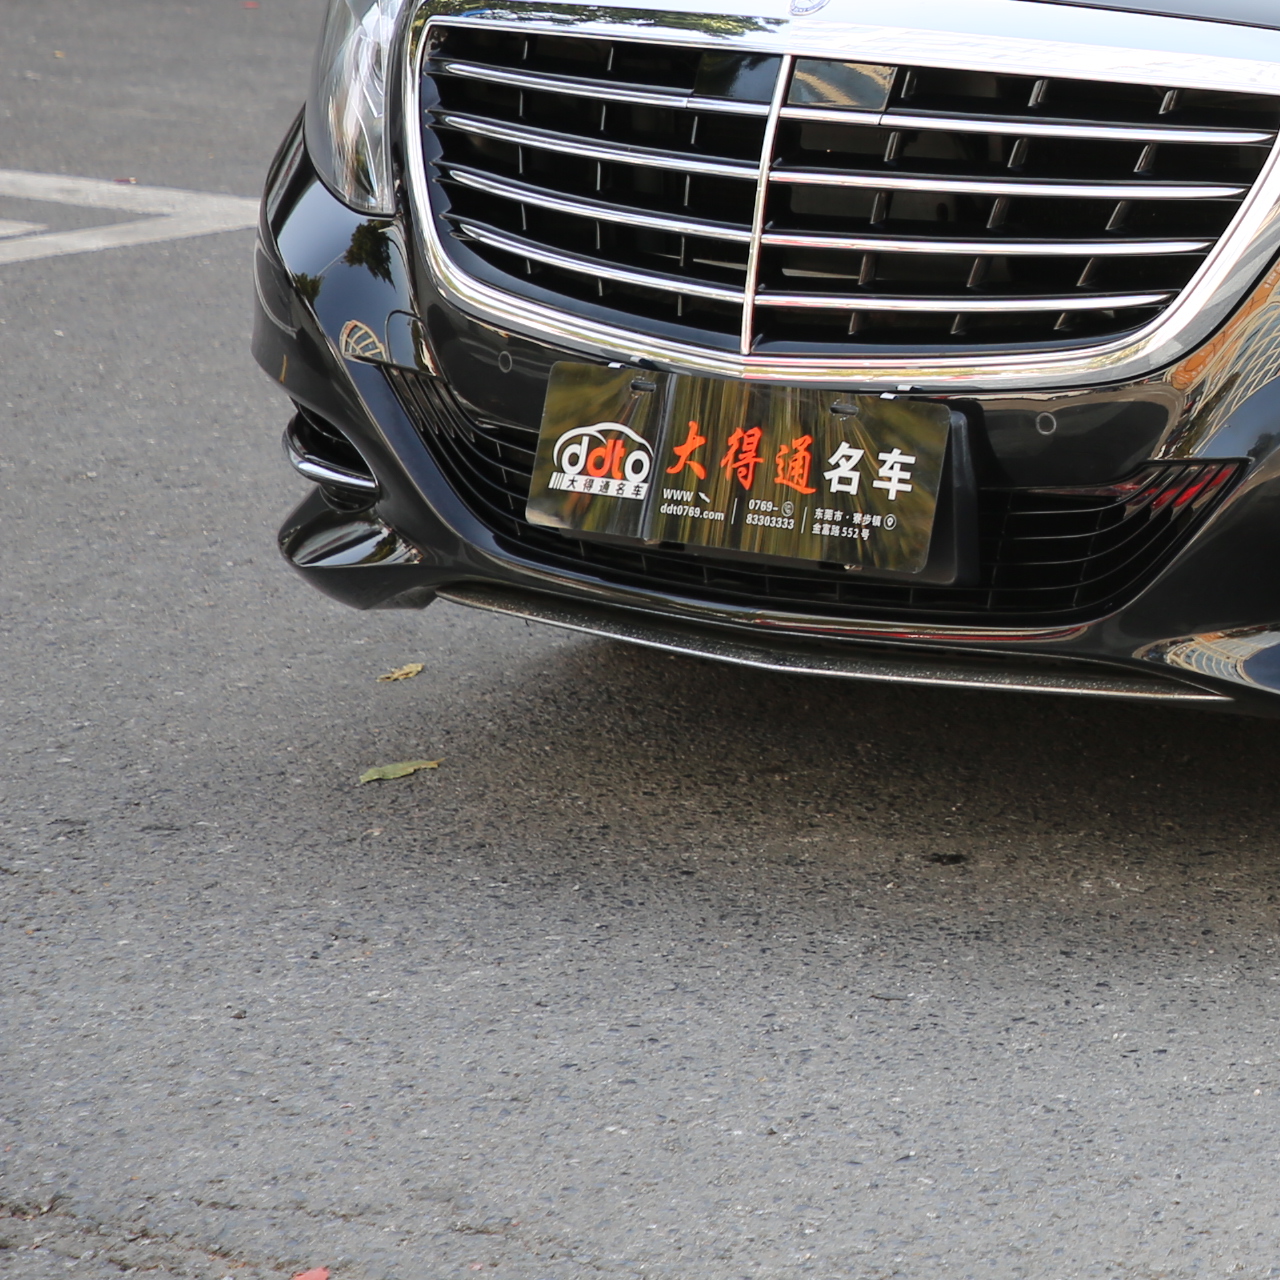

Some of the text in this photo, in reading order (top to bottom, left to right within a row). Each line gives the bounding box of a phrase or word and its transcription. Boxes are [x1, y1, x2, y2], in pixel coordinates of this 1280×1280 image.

[666, 421, 916, 500] 大得通名车
[566, 476, 644, 497] 大得通名车
[660, 503, 724, 520] ddt0769.com
[746, 514, 794, 530] 83303333
